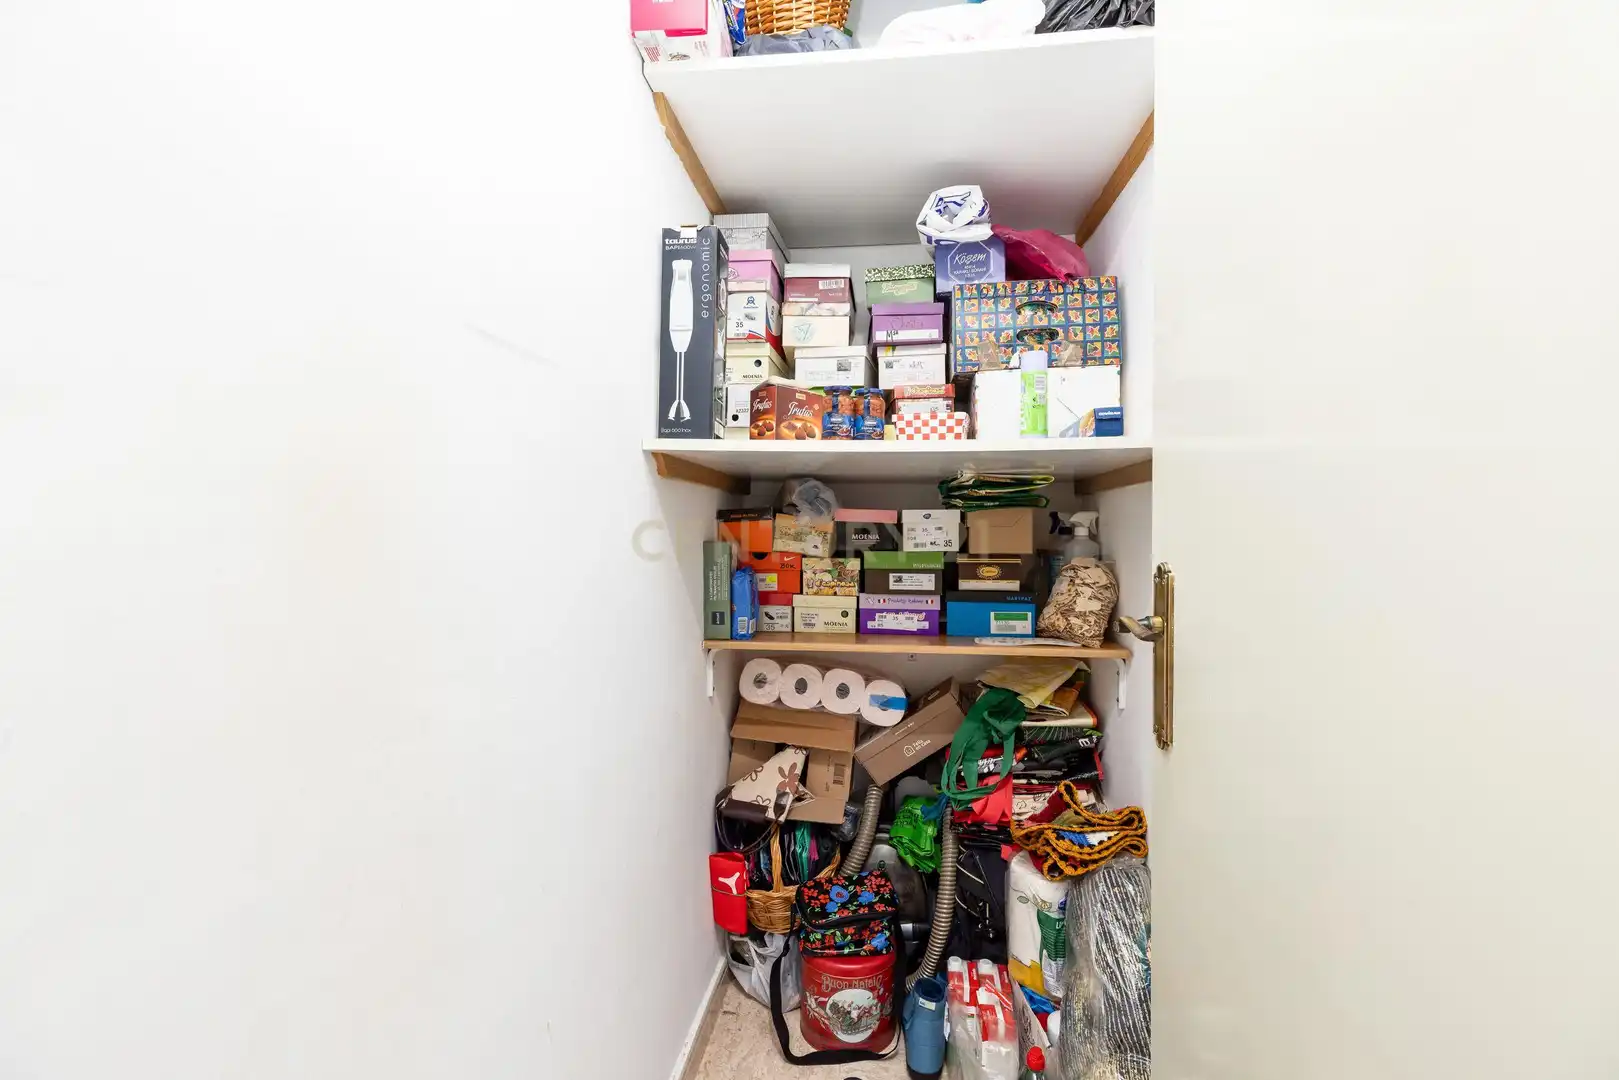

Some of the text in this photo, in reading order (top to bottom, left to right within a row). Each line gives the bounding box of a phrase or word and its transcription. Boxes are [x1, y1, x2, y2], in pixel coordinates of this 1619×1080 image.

[701, 238, 713, 318] ergonomic
[787, 401, 814, 418] Trufas
[943, 539, 953, 548] 35
[765, 623, 775, 631] 35
[821, 973, 849, 993] Buon
